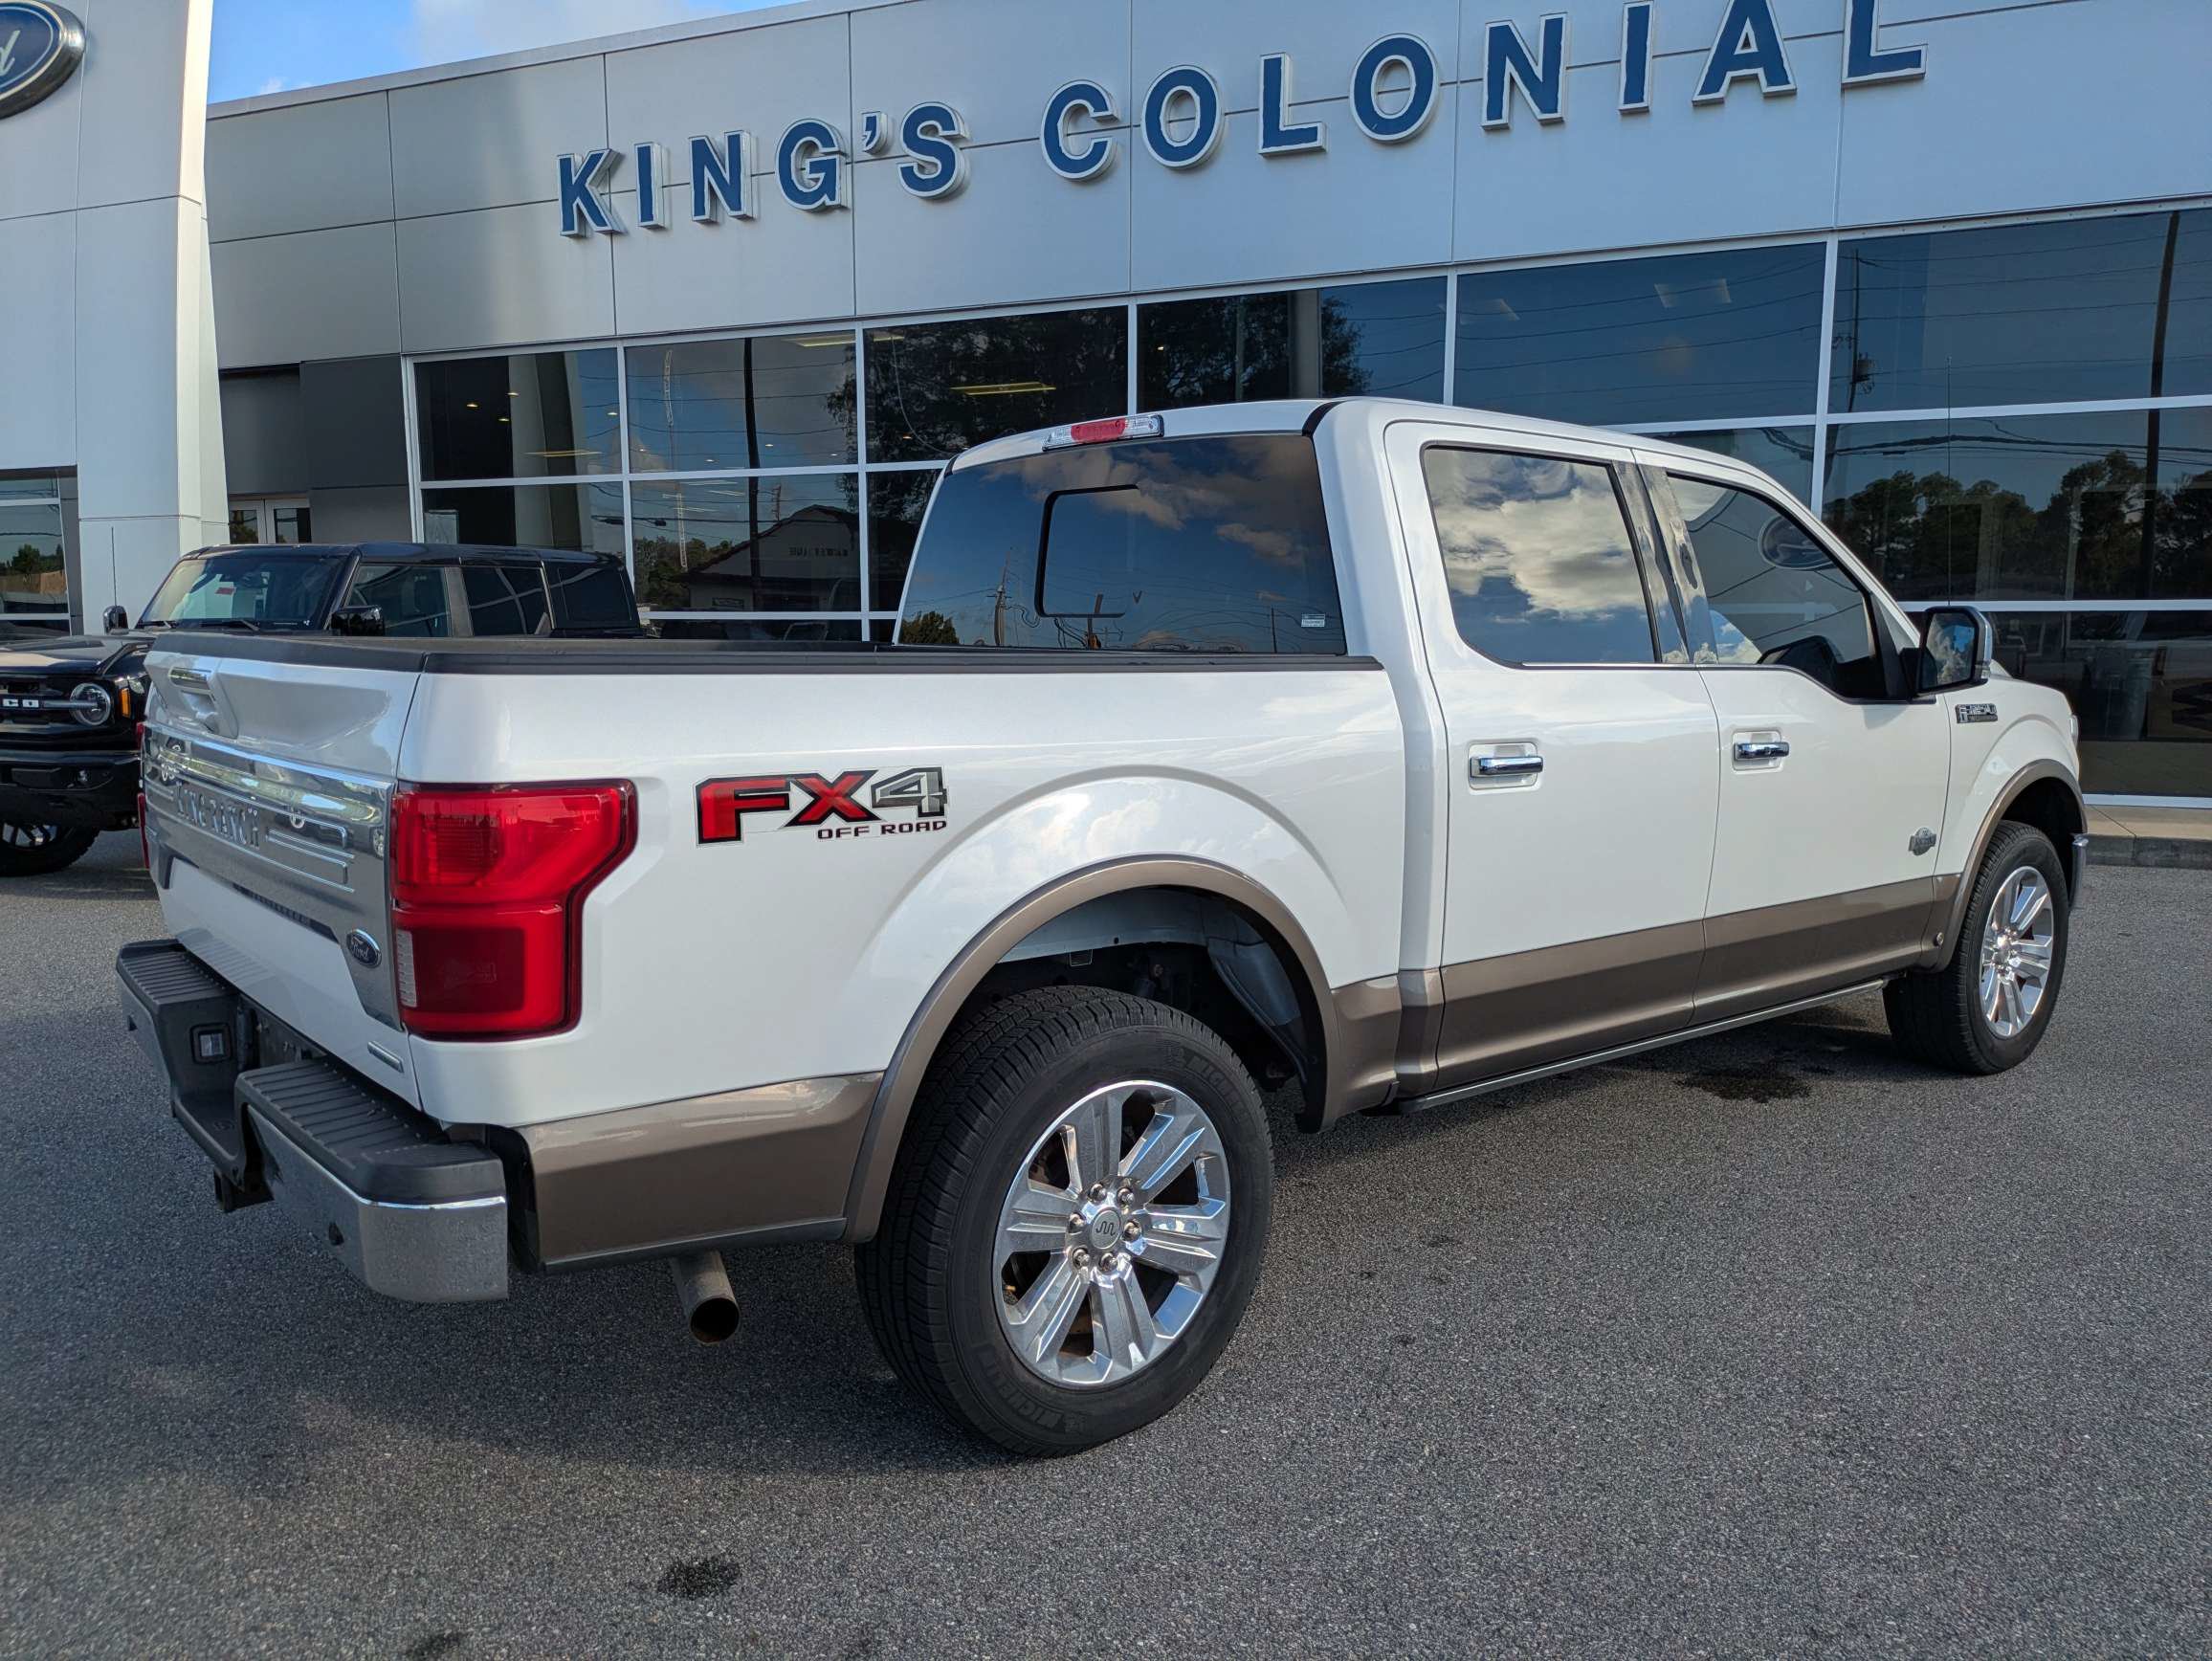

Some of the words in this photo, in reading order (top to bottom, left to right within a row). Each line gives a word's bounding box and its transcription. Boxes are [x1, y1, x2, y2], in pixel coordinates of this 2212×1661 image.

[555, 101, 970, 239] KING'S
[1041, 0, 1927, 182] COLONIAL
[696, 766, 948, 844] FX4
[817, 826, 870, 839] OFF
[880, 820, 947, 835] ROAD
